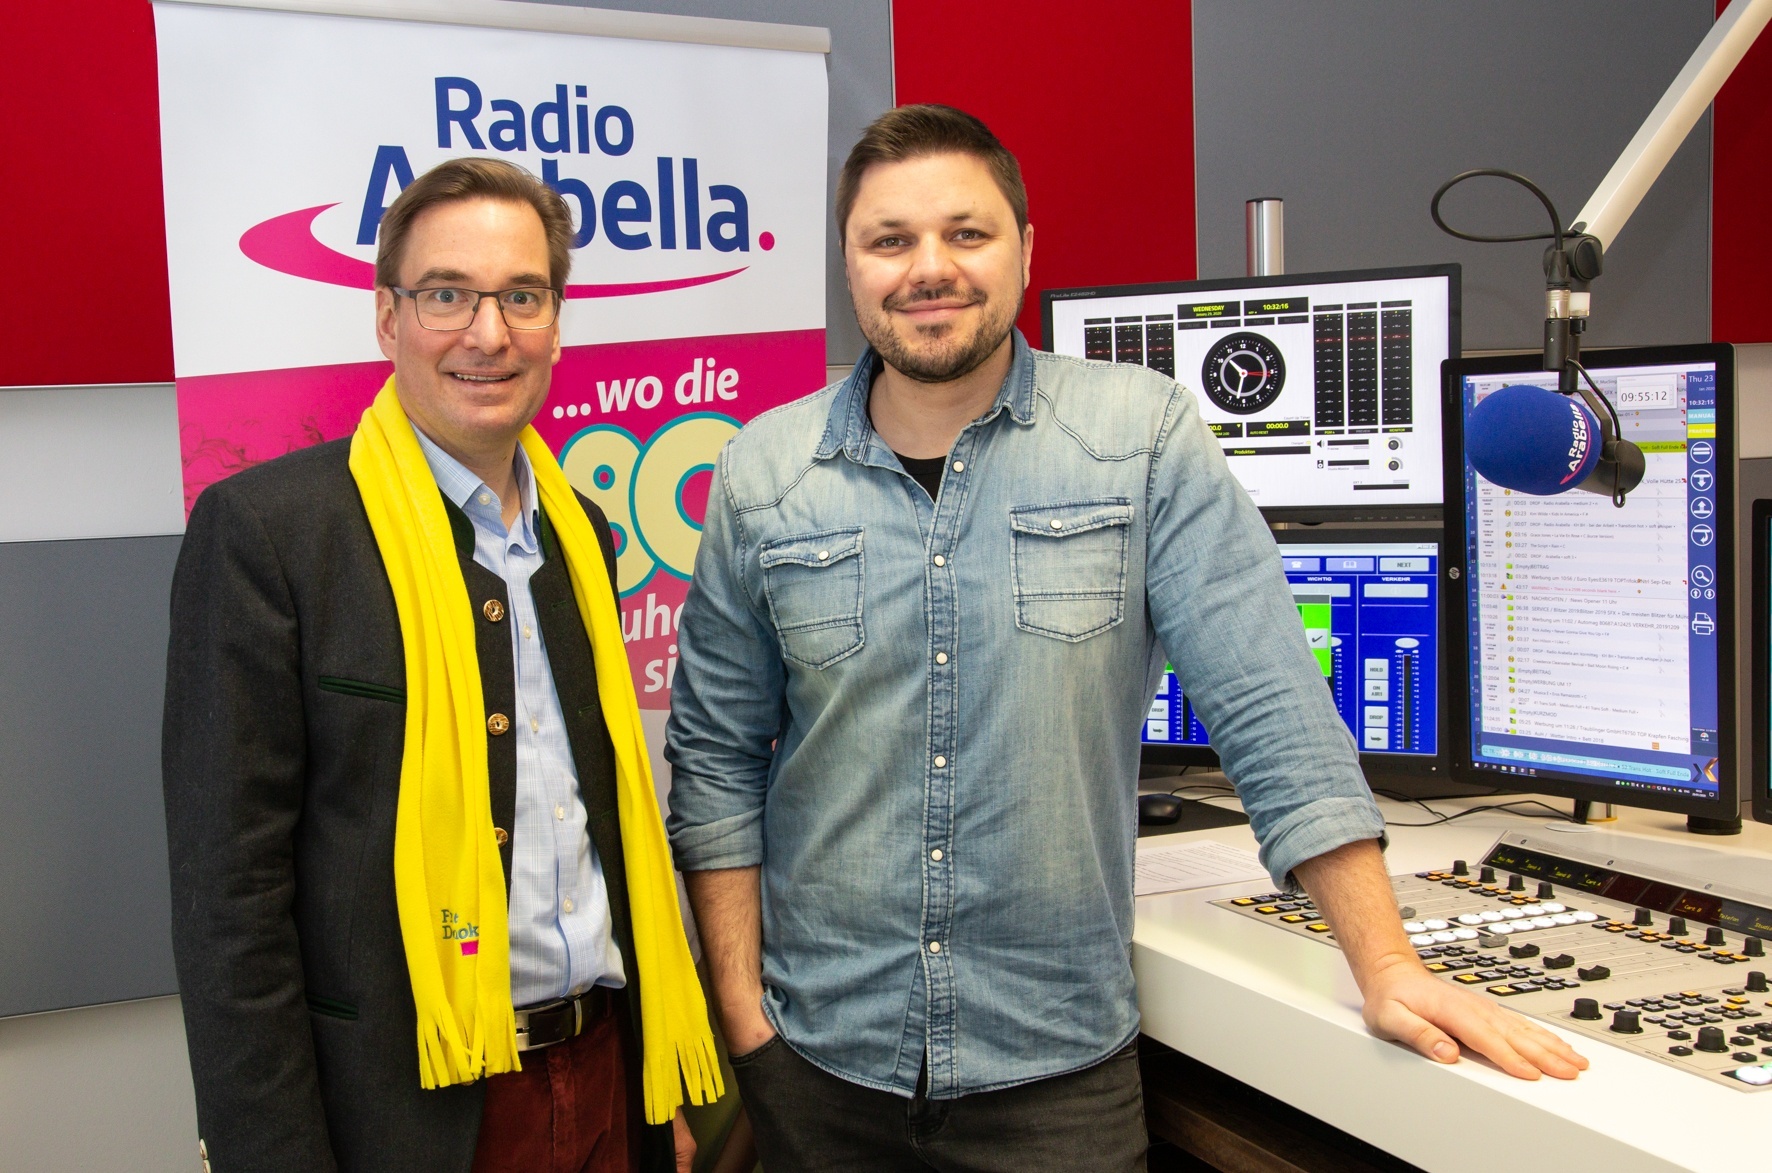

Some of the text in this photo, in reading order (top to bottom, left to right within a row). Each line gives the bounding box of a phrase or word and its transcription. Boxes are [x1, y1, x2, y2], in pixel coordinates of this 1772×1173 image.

[434, 76, 634, 157] Radio
[355, 145, 776, 253] Abella.
[1192, 304, 1225, 313] WEDNESDAY
[1262, 303, 1289, 311] 10:32:16
[674, 357, 740, 406] die
[1688, 375, 1702, 384] Thu
[1620, 390, 1668, 404] 09:55:12
[1567, 420, 1580, 458] Radio
[1531, 574, 1552, 582] Werbung
[1532, 617, 1554, 625] Werbung
[1534, 720, 1555, 730] Werbung
[1647, 733, 1667, 741] Krapfen
[1667, 735, 1690, 744] Fasching
[1684, 904, 1696, 912] Cart
[1719, 912, 1740, 923] Telefon
